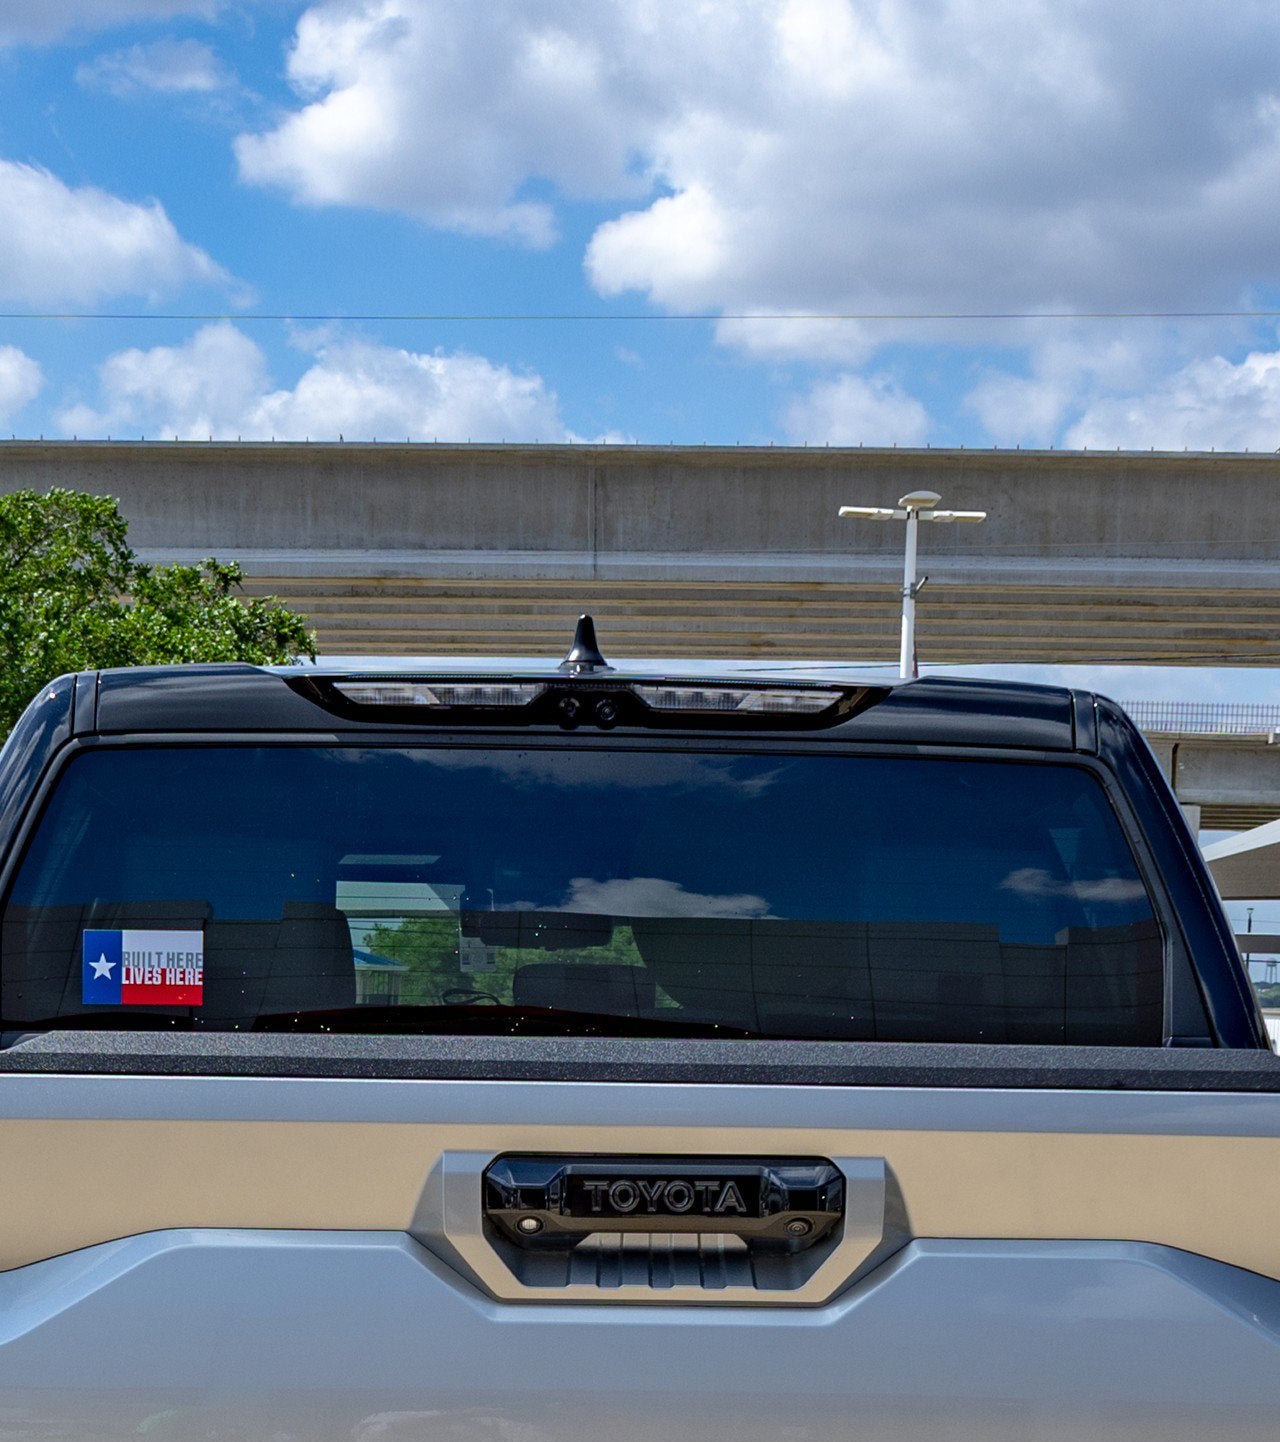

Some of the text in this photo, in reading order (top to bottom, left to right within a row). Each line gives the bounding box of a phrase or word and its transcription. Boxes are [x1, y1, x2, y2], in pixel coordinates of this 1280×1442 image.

[122, 951, 203, 969] BUILT HERE
[122, 968, 203, 986] LIVES HERE
[583, 1179, 747, 1213] TOYOTA
